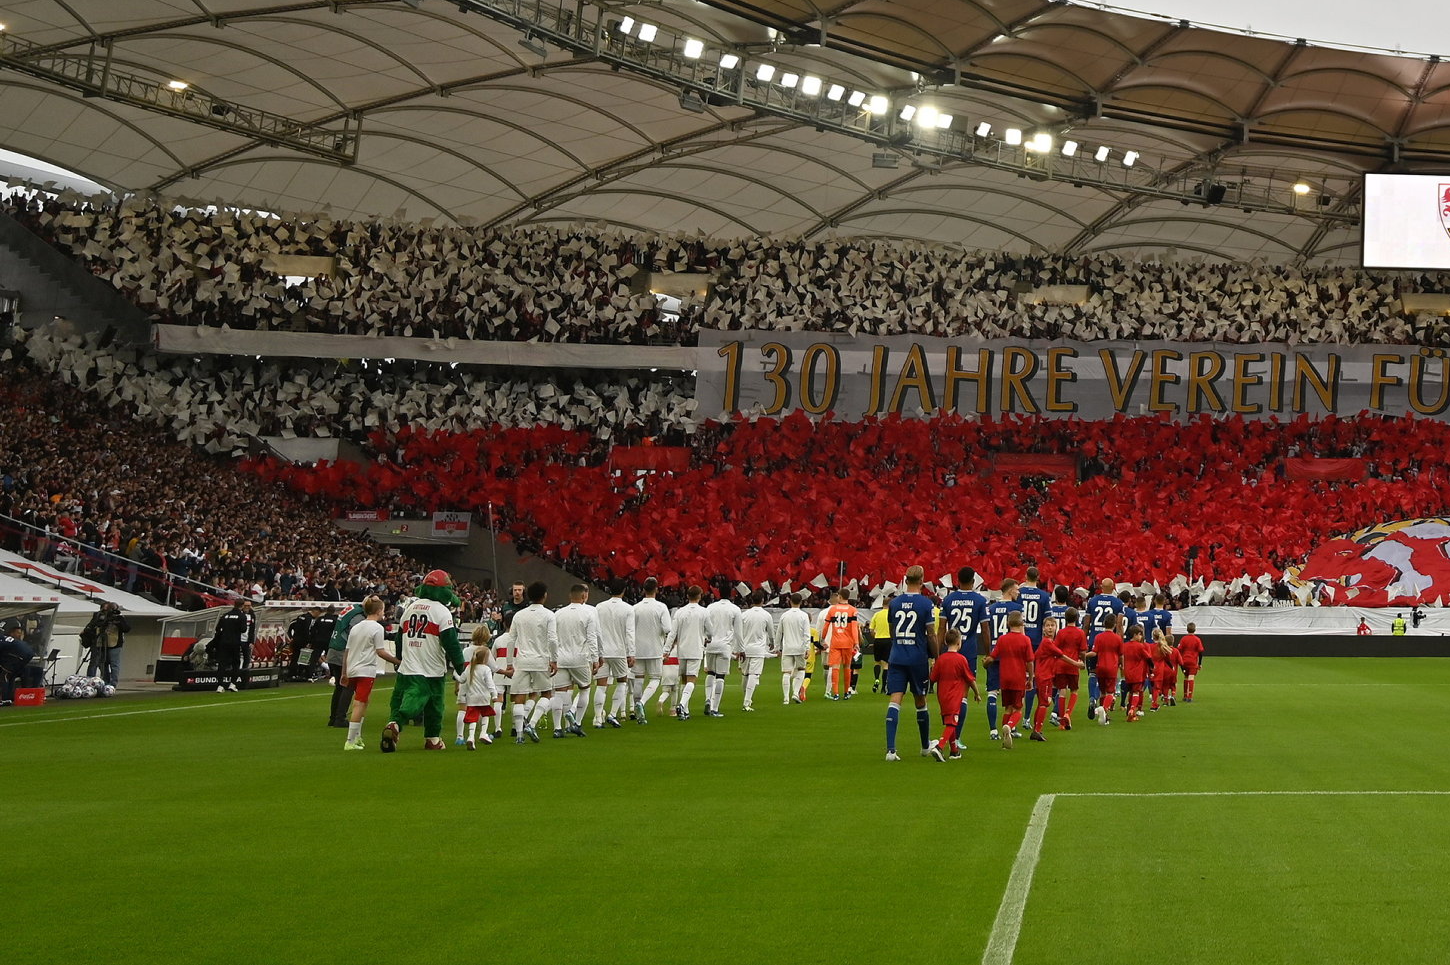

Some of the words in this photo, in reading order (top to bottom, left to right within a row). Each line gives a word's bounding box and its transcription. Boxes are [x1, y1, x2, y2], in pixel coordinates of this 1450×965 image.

[718, 340, 841, 415] 130
[864, 342, 1079, 417] JAHRE
[1098, 347, 1341, 414] VEREIN
[835, 611, 849, 628] 33
[895, 610, 918, 638] 22
[1022, 600, 1039, 622] 10
[407, 613, 428, 639] 92
